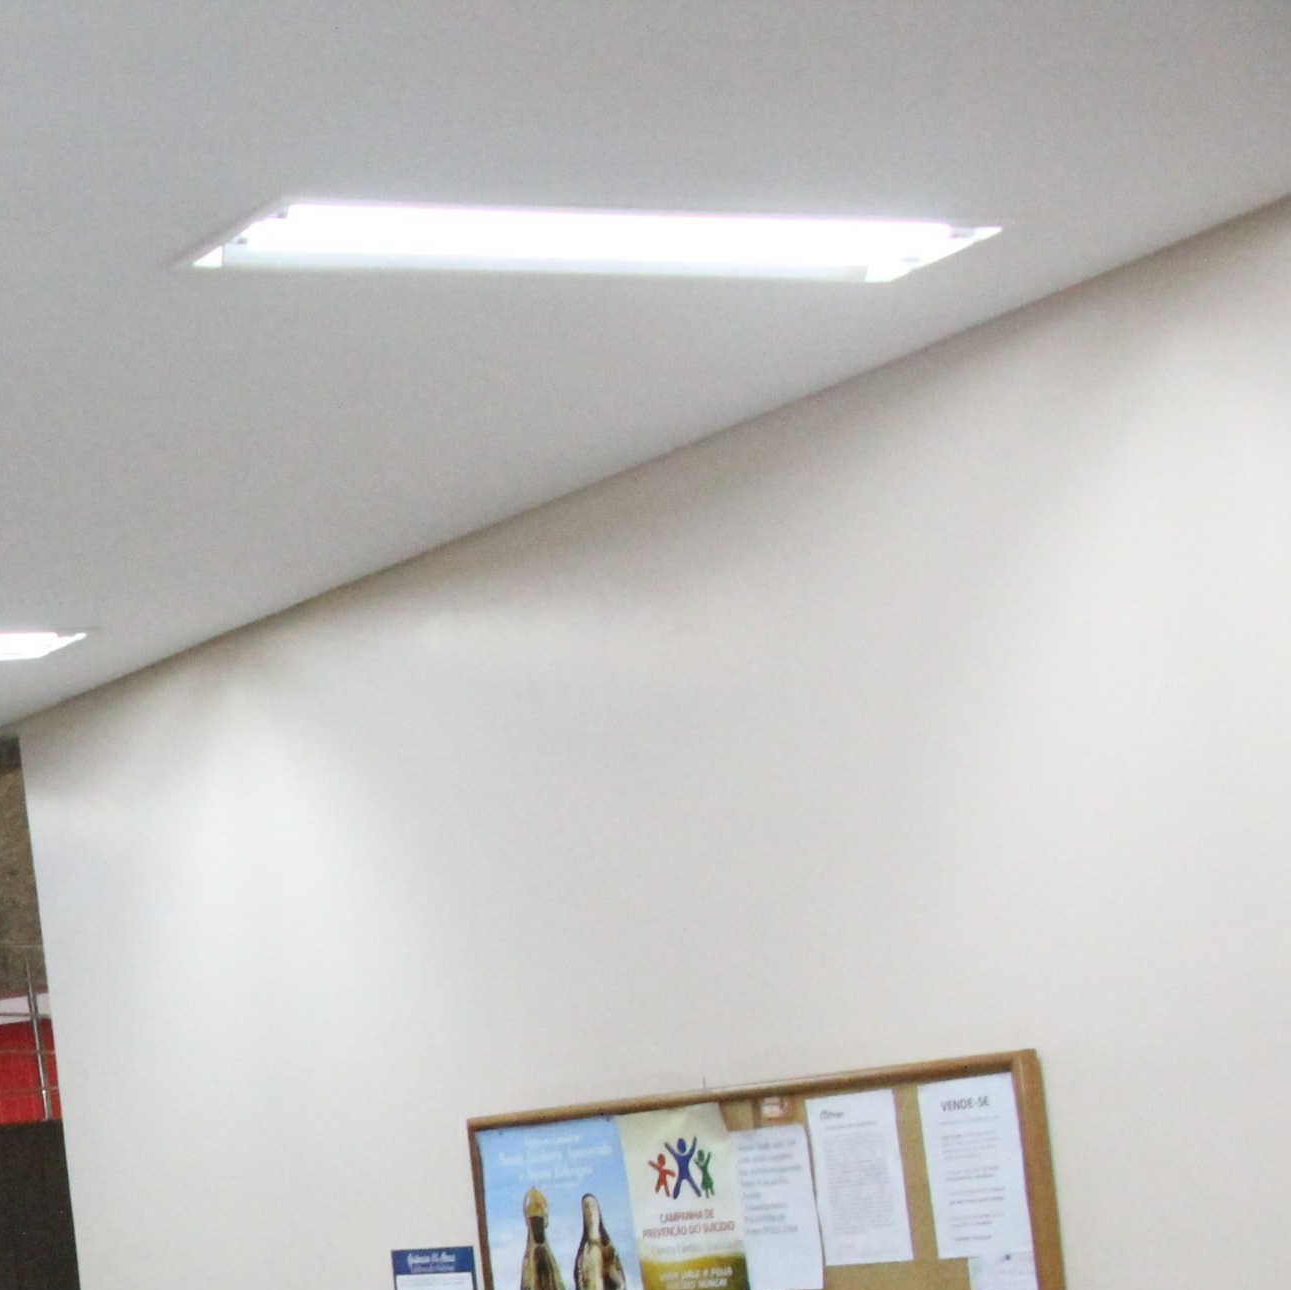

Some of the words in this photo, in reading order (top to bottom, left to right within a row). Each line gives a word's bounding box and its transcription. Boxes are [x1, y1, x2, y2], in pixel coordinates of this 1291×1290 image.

[940, 1095, 990, 1113] VENDE-SE
[659, 1209, 703, 1224] CAMPANHA
[704, 1207, 715, 1219] DE
[642, 1225, 687, 1239] PREVENÇÃO
[688, 1223, 701, 1235] DO
